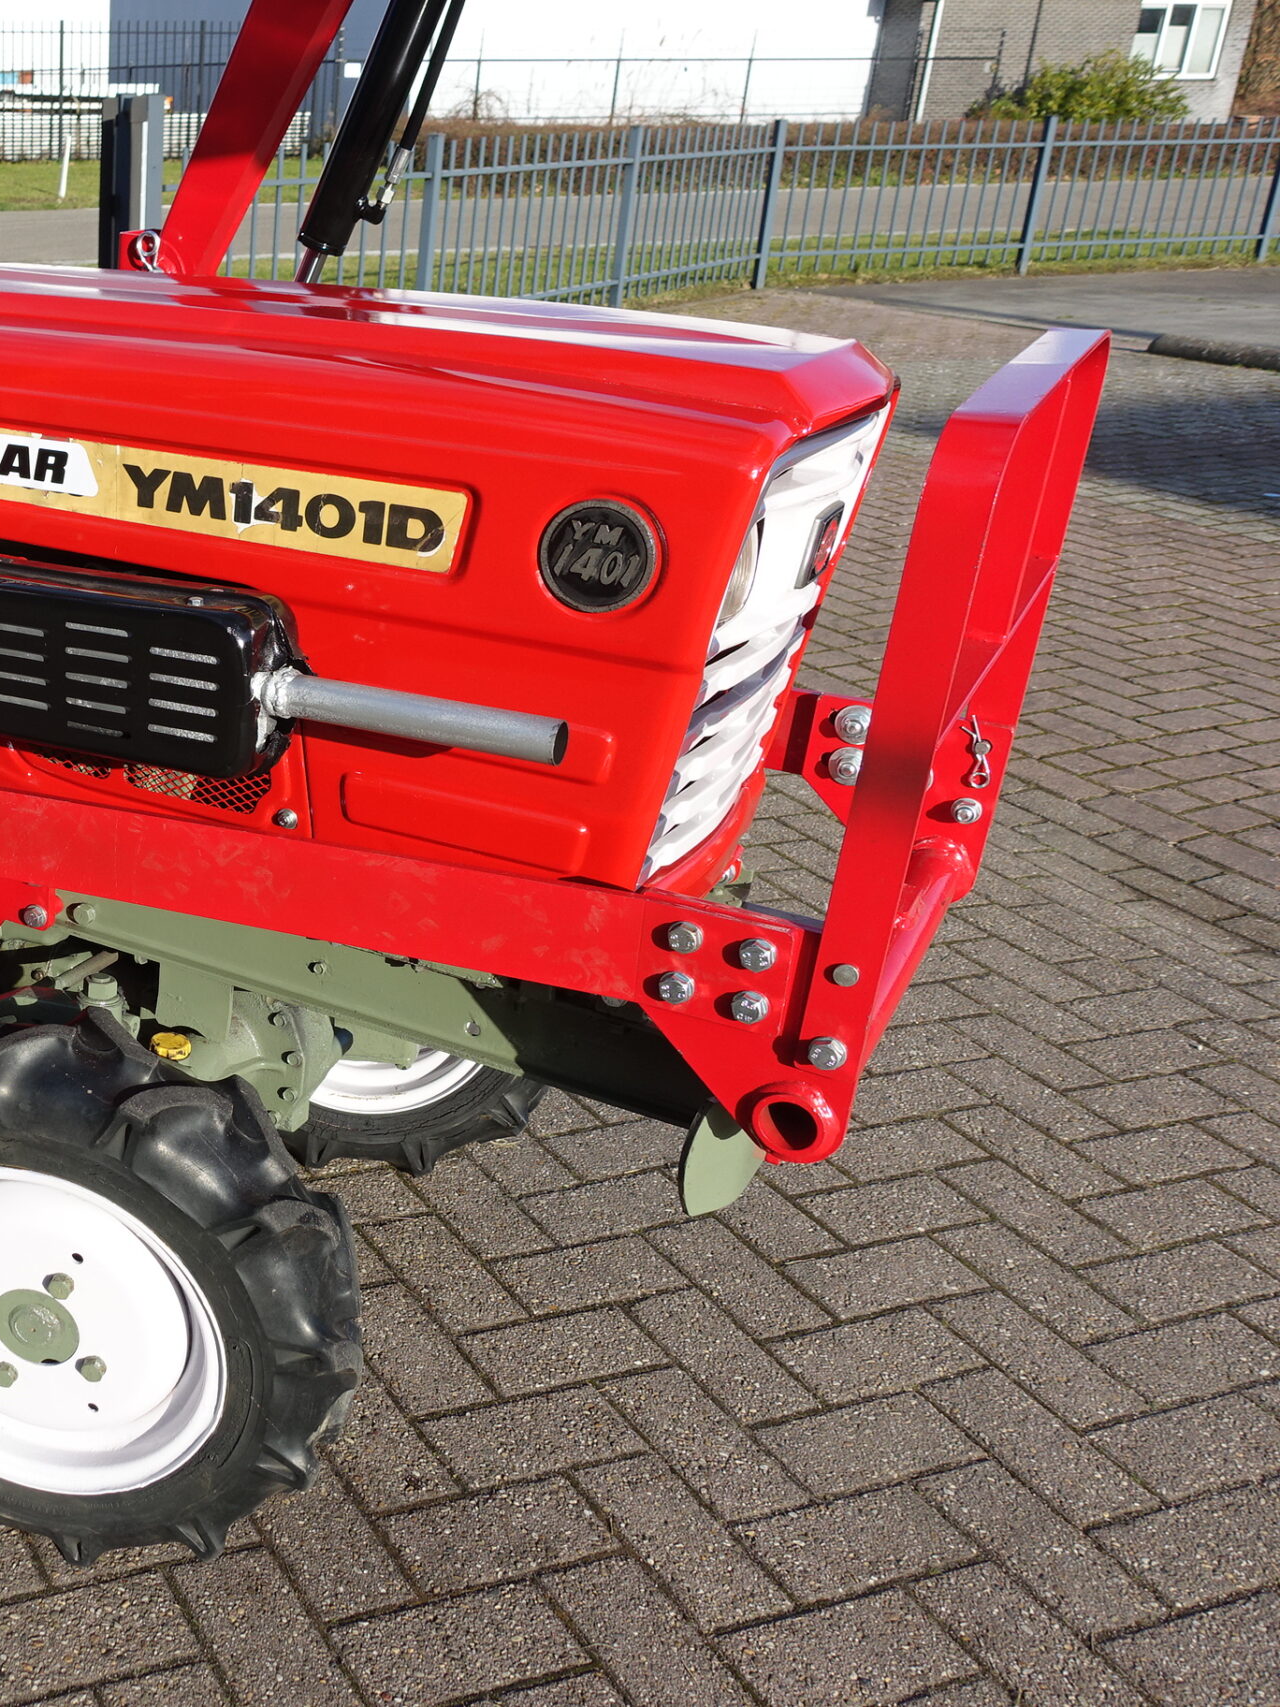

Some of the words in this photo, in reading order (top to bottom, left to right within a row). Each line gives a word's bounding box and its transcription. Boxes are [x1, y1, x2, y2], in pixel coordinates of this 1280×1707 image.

[122, 463, 445, 553] YM1401D
[571, 519, 624, 546] YM
[553, 543, 640, 588] 1401
